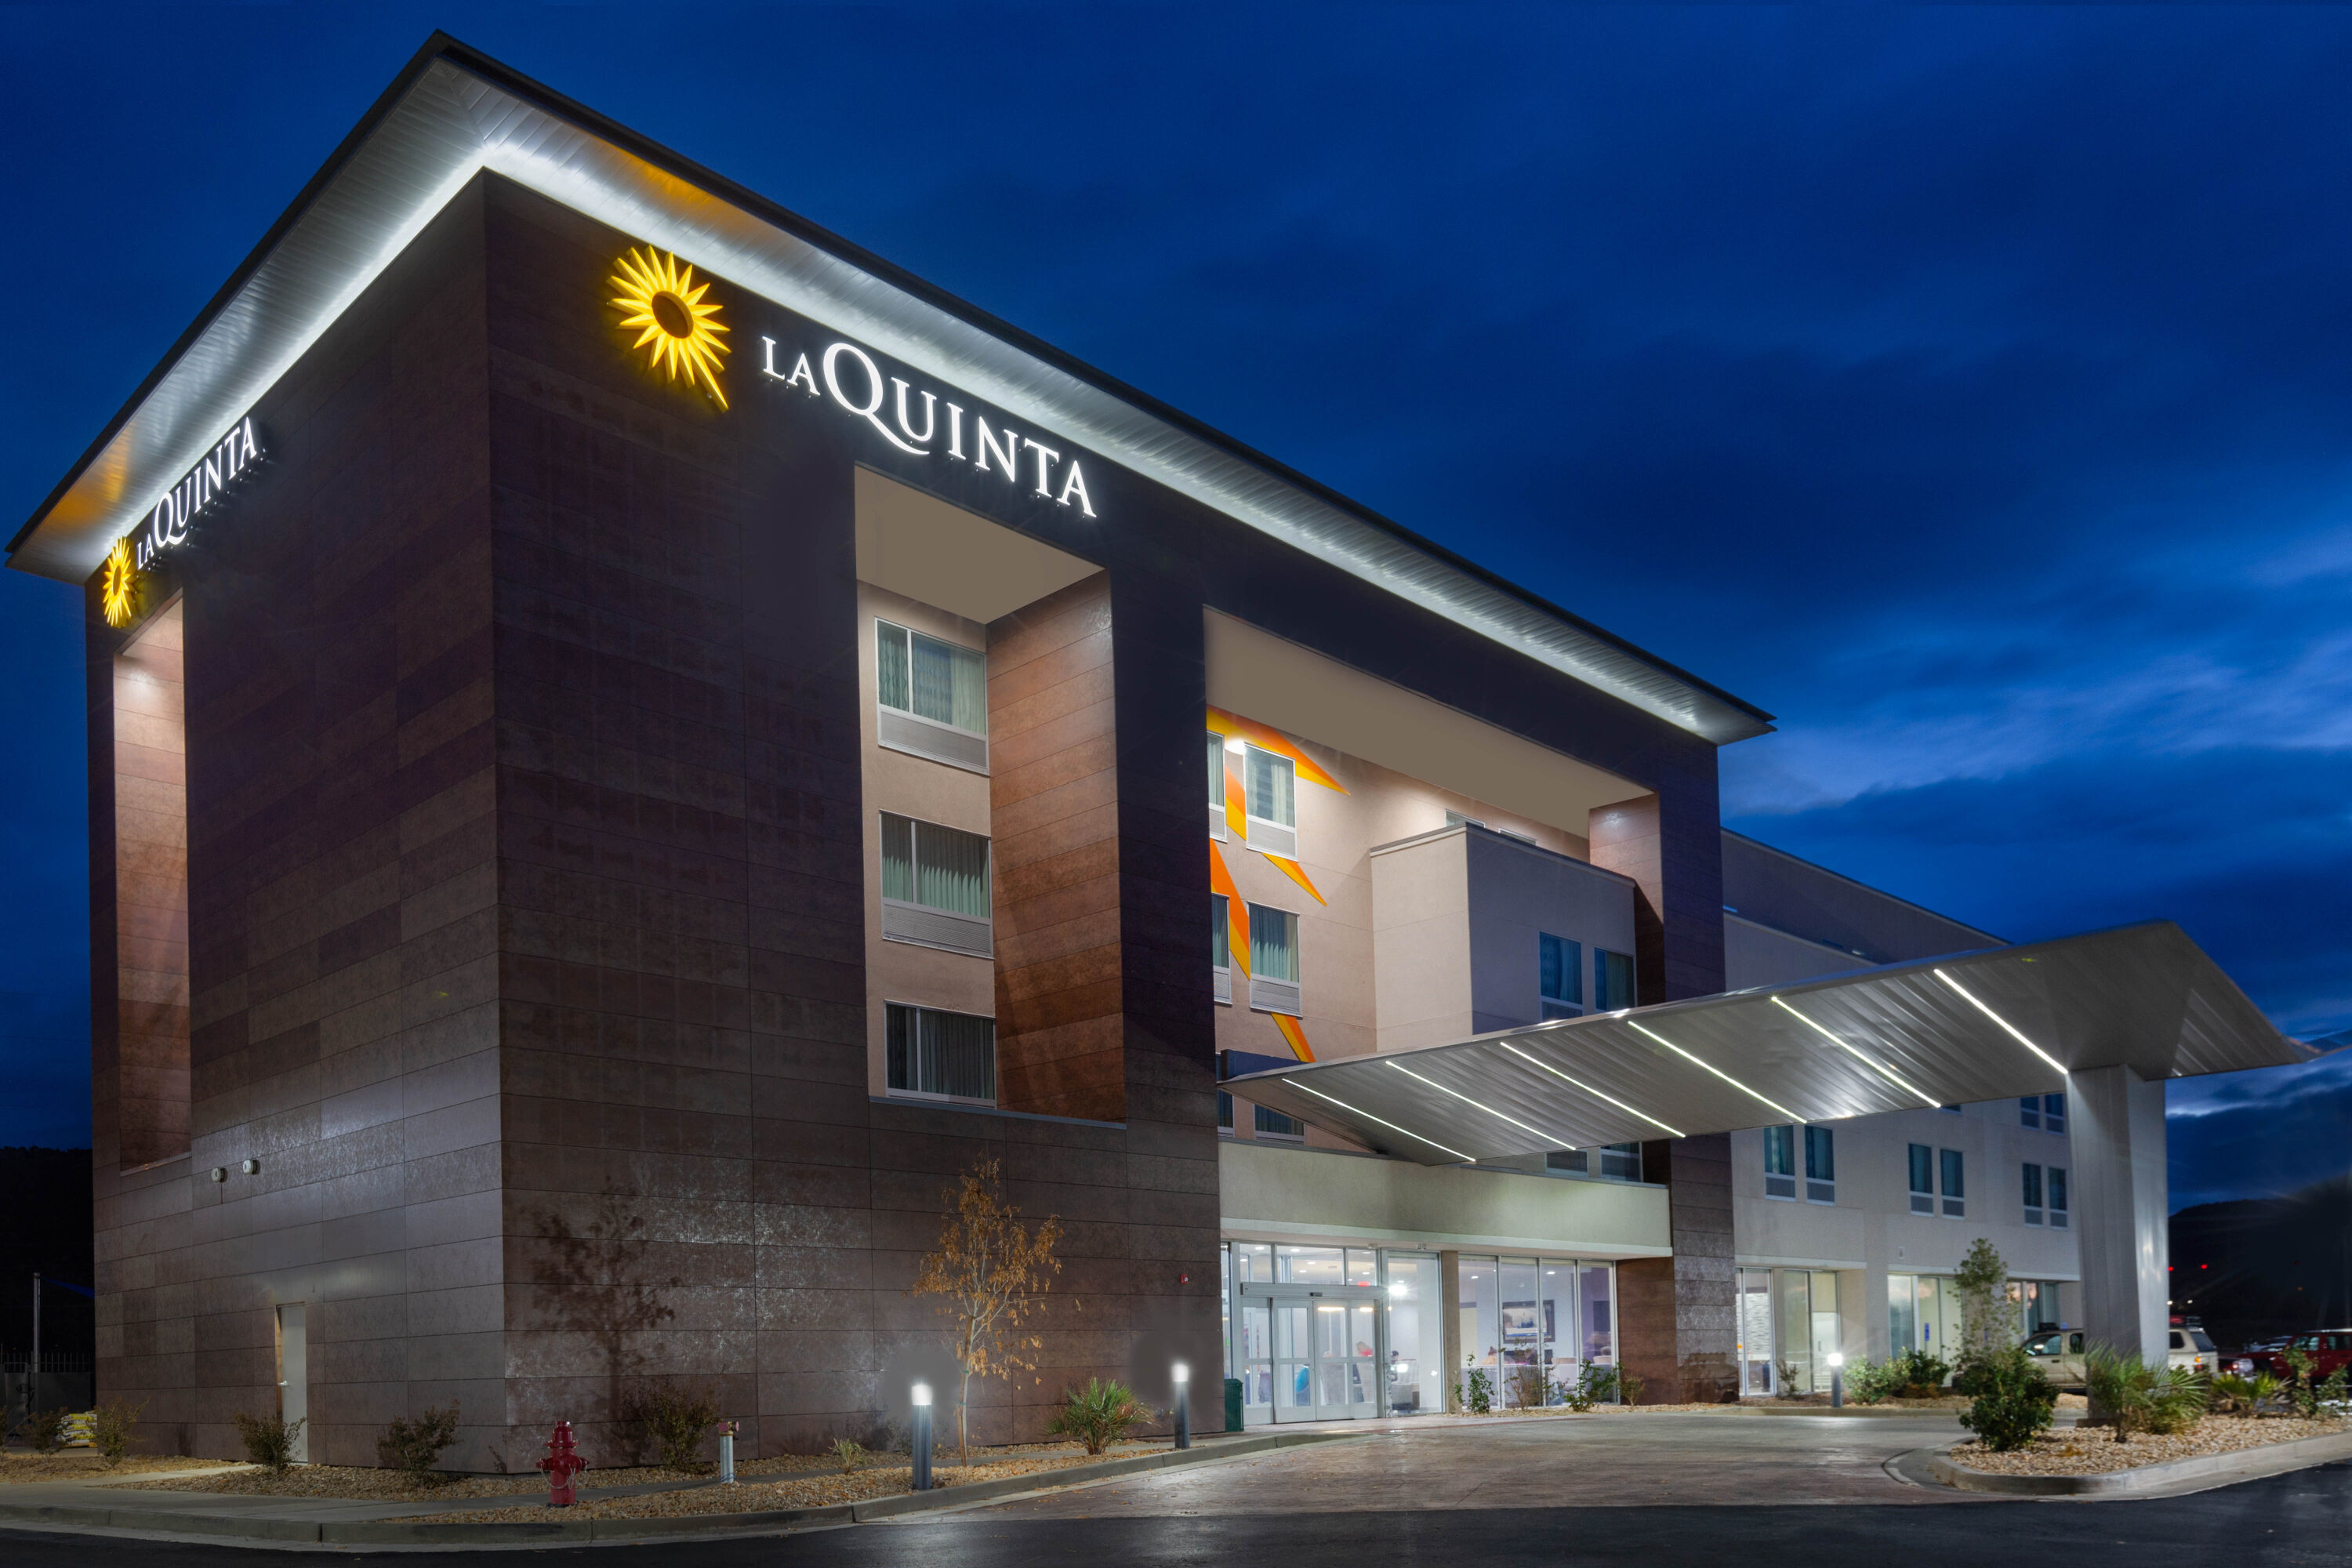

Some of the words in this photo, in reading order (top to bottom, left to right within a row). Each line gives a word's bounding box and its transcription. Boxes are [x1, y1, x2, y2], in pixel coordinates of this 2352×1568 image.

[136, 533, 154, 571] LA
[154, 416, 258, 549] QUINTA
[761, 336, 821, 396] LA
[822, 342, 1098, 518] QUINTA
